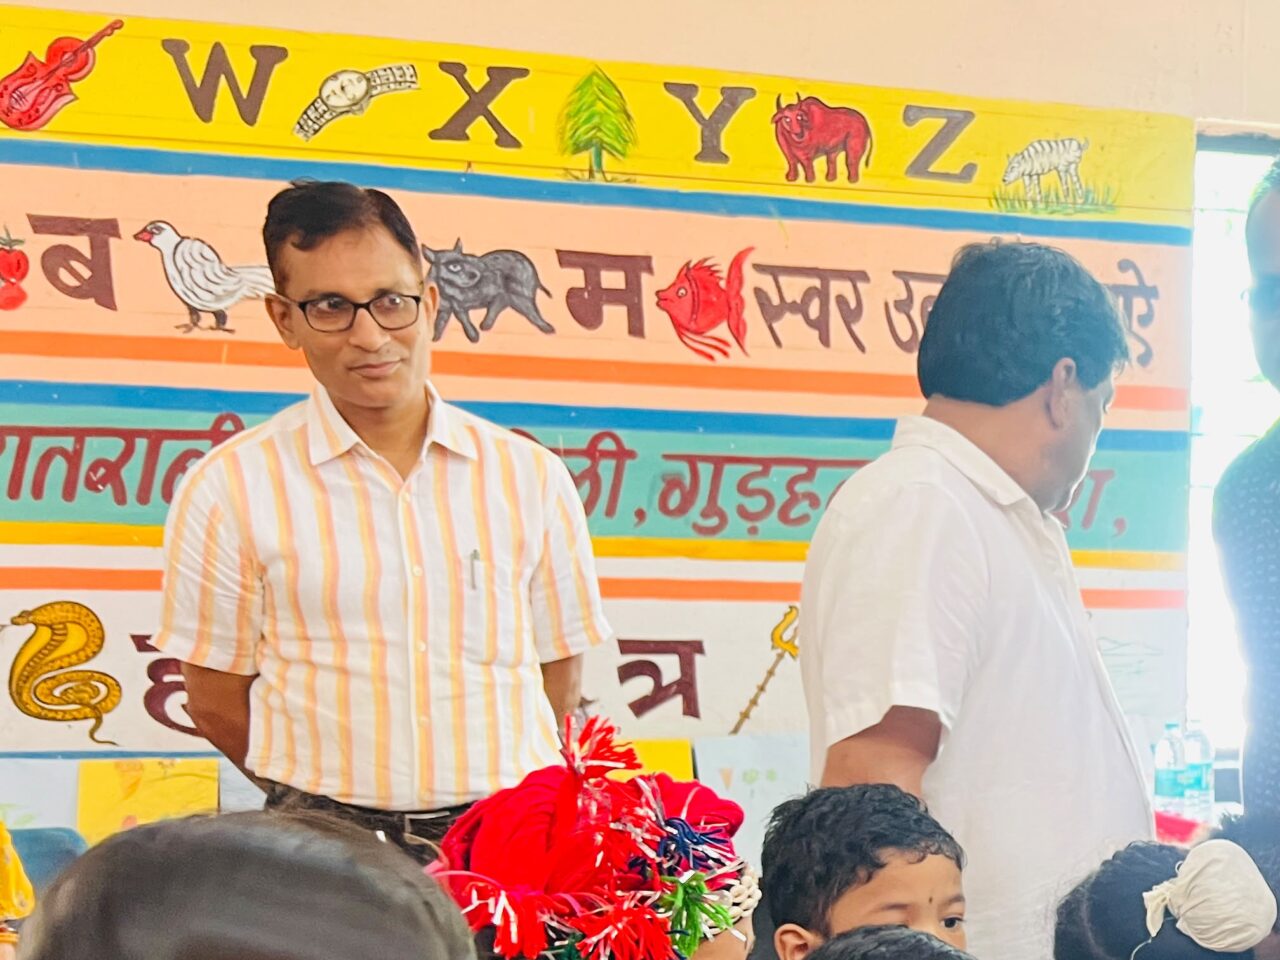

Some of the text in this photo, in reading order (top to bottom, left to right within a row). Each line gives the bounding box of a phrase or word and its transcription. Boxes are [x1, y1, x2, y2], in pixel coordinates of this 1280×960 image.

[161, 38, 977, 184] W X Y Z
[26, 213, 122, 312] ब
[556, 249, 653, 339] म
[752, 263, 870, 353] स्वर
[616, 639, 706, 719] त्र
